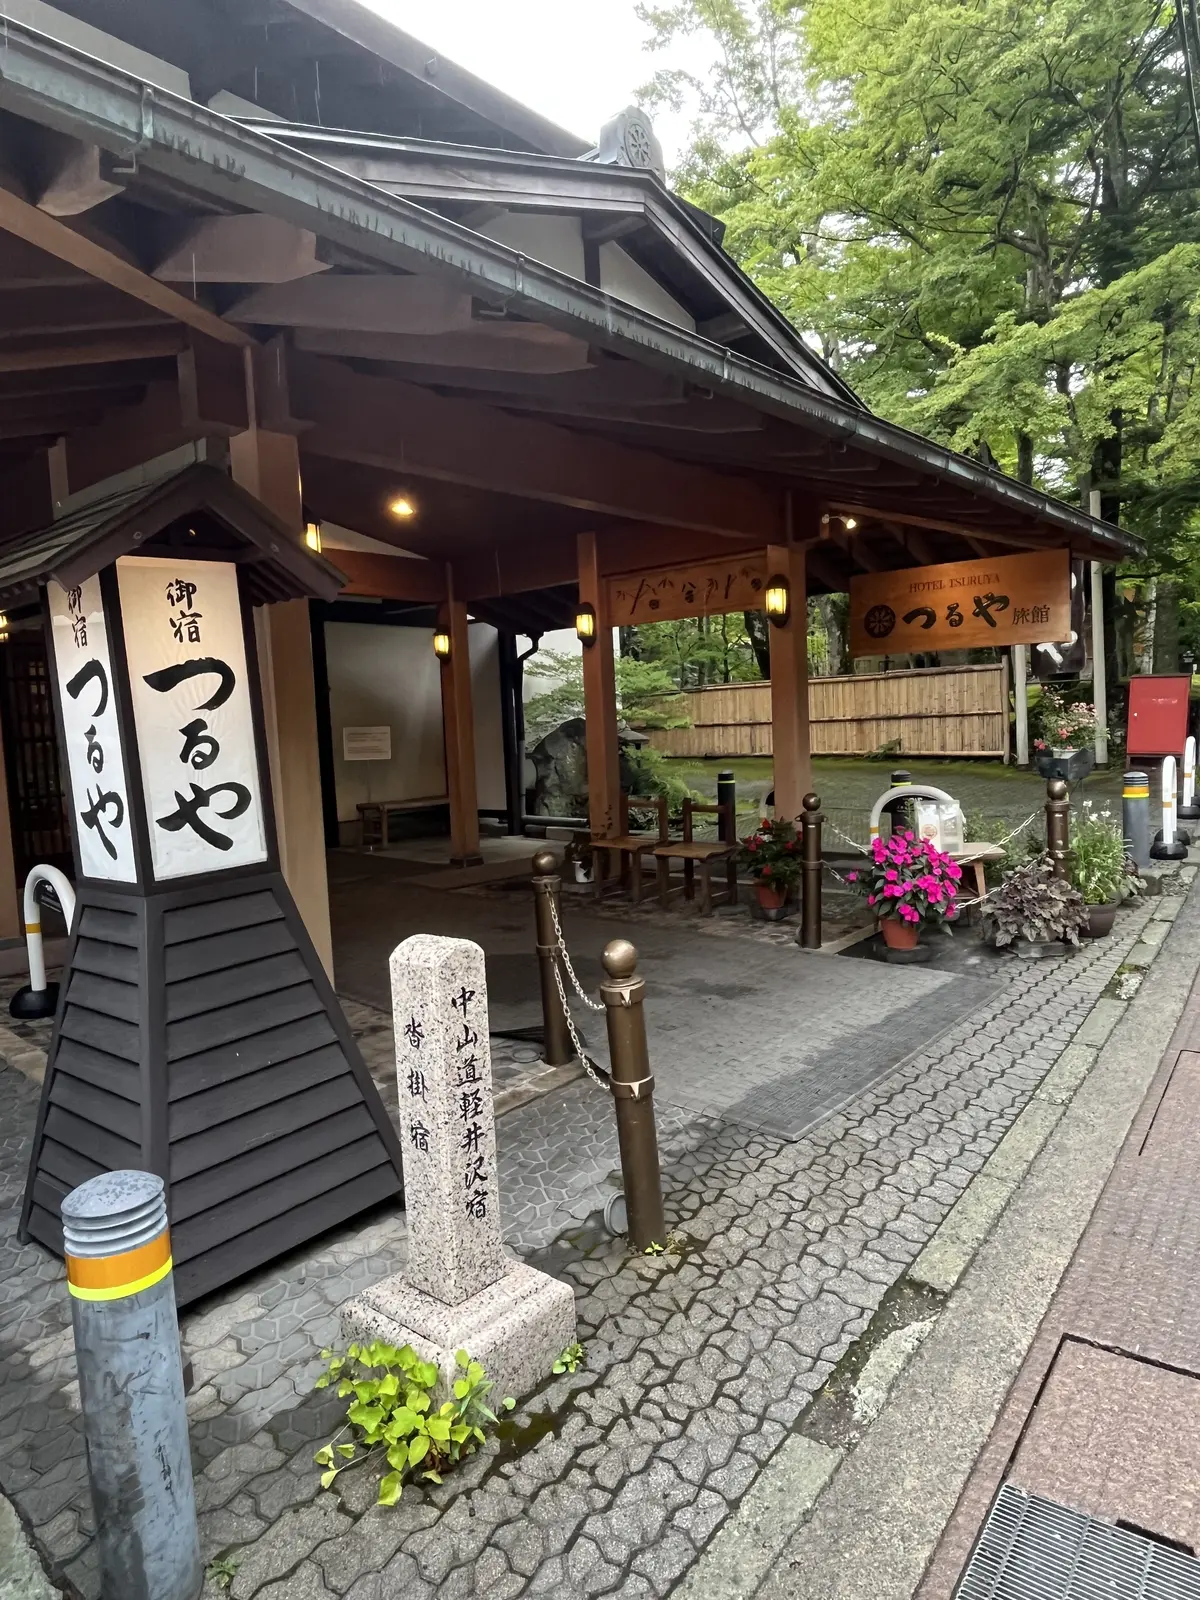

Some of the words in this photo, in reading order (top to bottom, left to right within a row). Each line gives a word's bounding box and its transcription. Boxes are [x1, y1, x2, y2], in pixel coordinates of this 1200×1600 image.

[67, 584, 88, 648] 御宿
[166, 578, 202, 643] 御宿
[902, 592, 1009, 629] つるや
[1012, 605, 1050, 625] 旅館
[909, 577, 945, 593] HOTEL
[949, 573, 1001, 589] TSURUYA
[66, 658, 124, 860] つるや
[143, 657, 251, 850] つるや
[404, 1017, 429, 1153] 沓掛宿
[452, 986, 489, 1221] 中山道軽井沢宿
